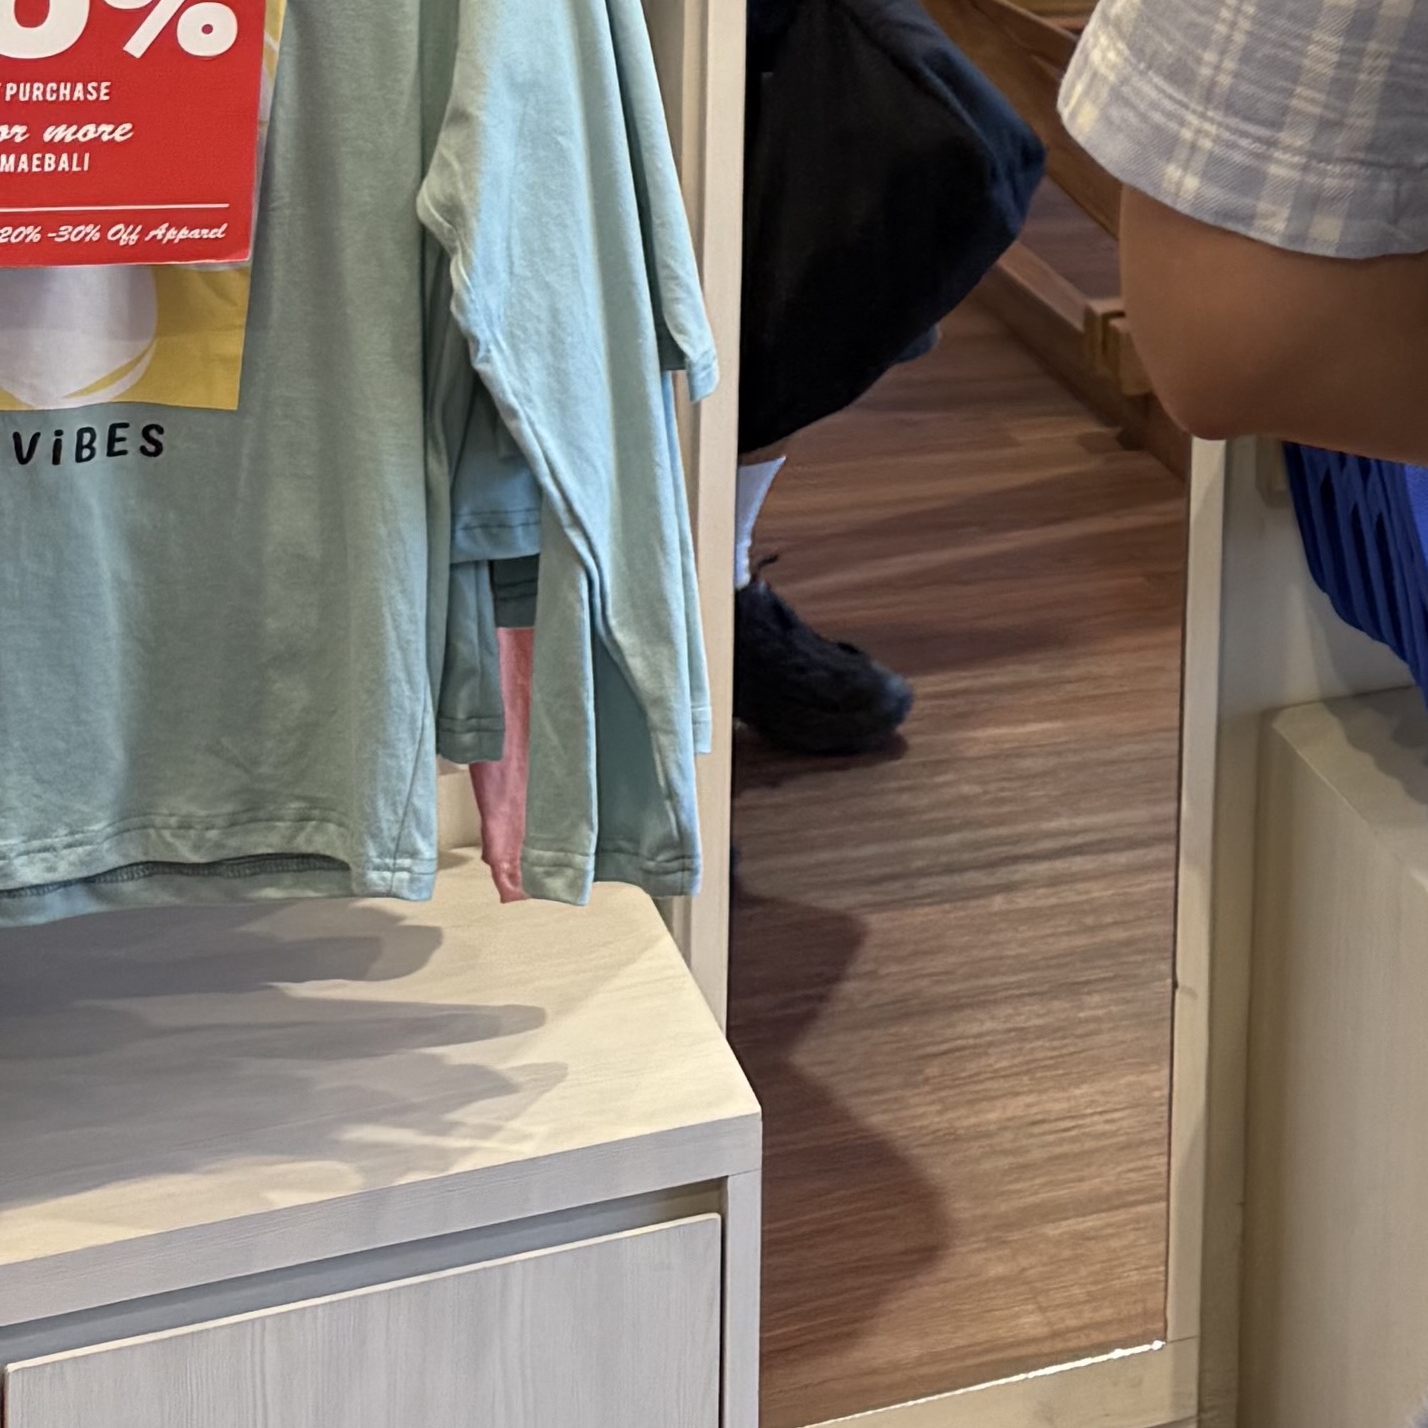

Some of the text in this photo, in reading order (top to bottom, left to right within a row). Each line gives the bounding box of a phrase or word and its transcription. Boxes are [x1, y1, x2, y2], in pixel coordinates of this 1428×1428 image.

[5, 81, 112, 103] PURCHASE
[42, 121, 134, 144] more
[0, 152, 91, 174] MAEBALI
[47, 224, 101, 244] -30%
[107, 223, 143, 247] Off
[144, 222, 230, 245] Apparel
